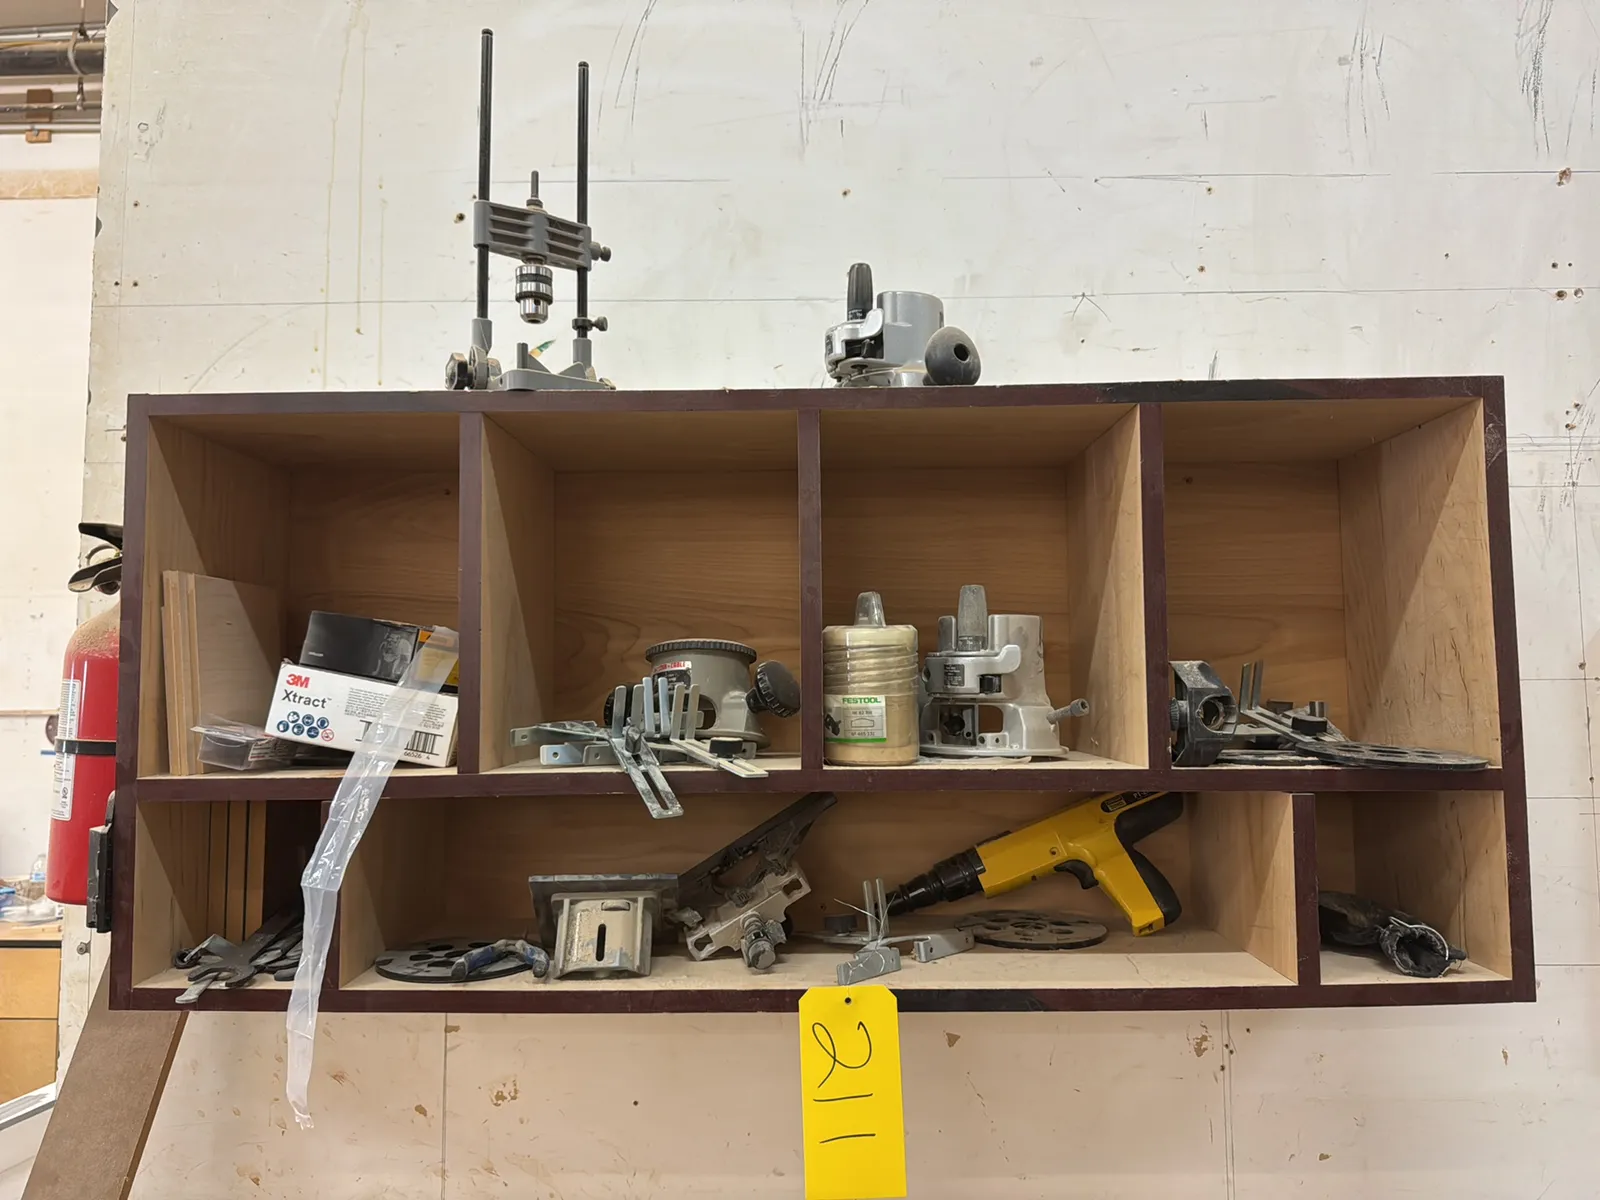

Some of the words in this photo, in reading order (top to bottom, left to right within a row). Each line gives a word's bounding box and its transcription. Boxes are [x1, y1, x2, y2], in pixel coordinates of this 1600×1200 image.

[286, 673, 310, 689] 3M
[281, 688, 327, 709] Xtract
[811, 1020, 877, 1145] 211
